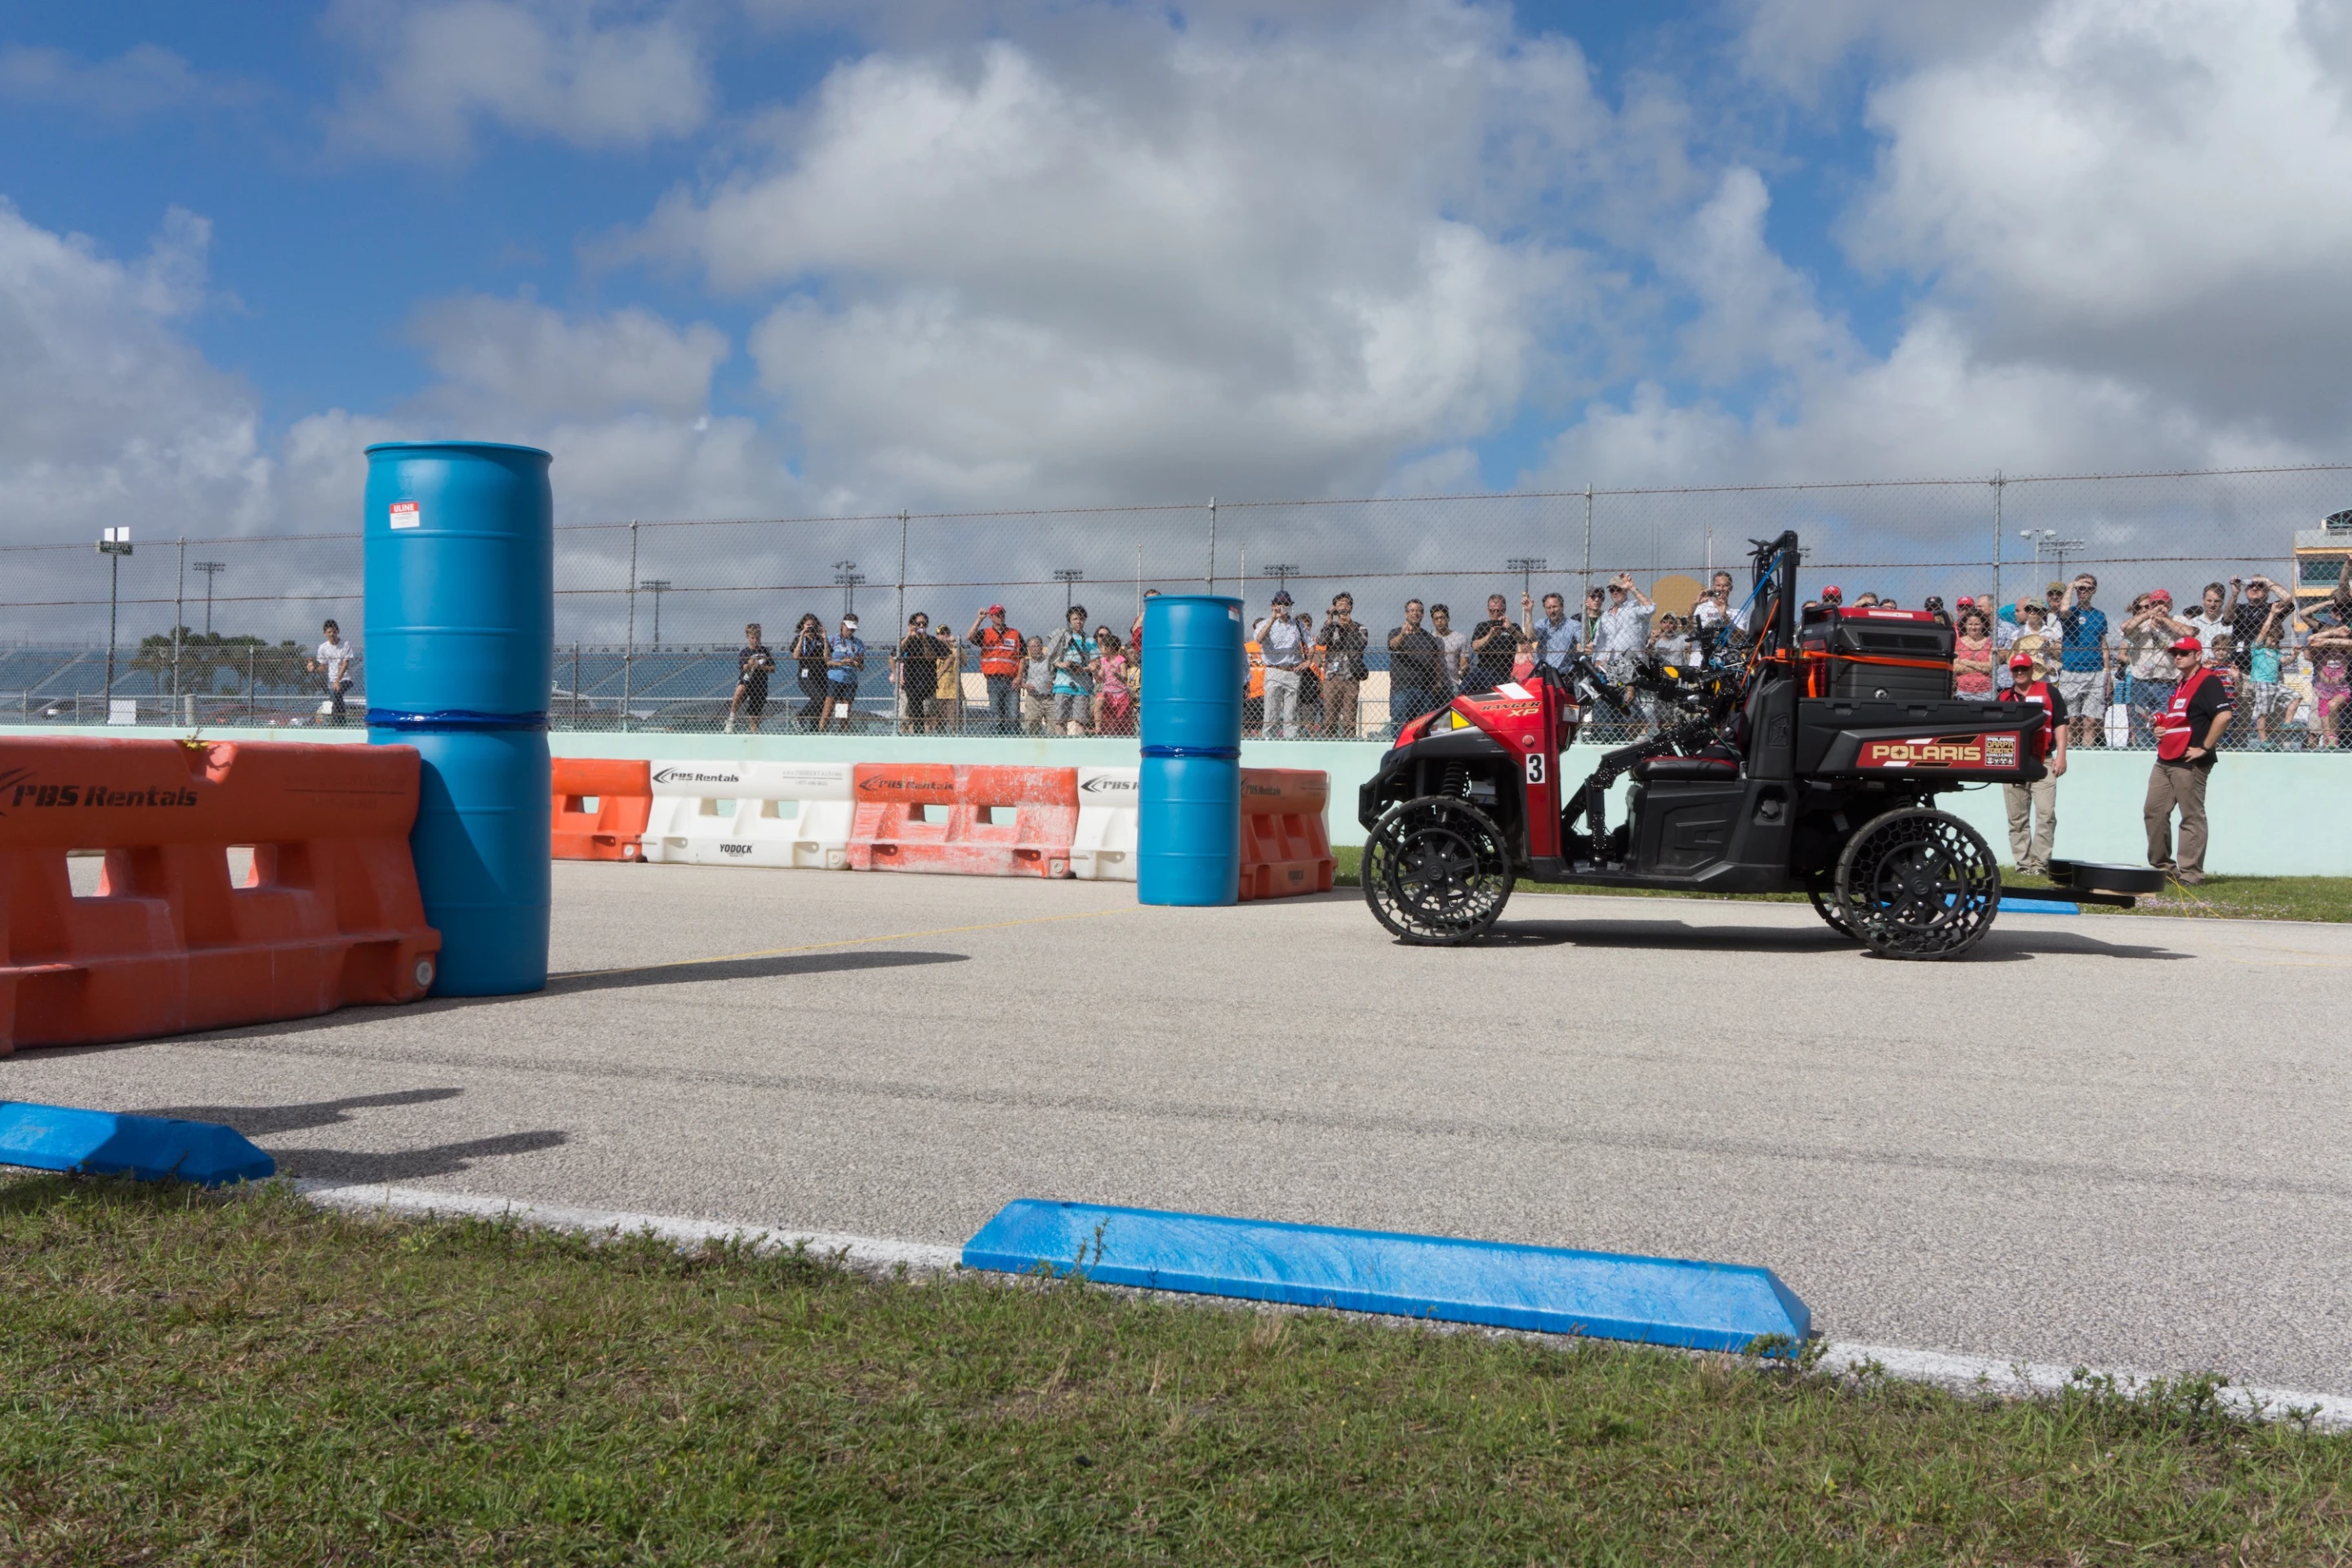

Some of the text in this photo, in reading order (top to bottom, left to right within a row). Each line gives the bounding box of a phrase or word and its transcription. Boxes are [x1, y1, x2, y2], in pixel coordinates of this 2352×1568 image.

[394, 503, 414, 512] ULINE
[1481, 702, 1541, 710] RANGER
[1507, 708, 1539, 717] XP
[1873, 746, 1981, 760] POLARIS
[1528, 755, 1543, 782] 3
[670, 773, 739, 782] PBS Rentals
[906, 782, 954, 790] Rentals
[1102, 781, 1130, 790] PBS
[12, 785, 198, 807] PBS Rentals
[719, 844, 753, 854] YODOCK
